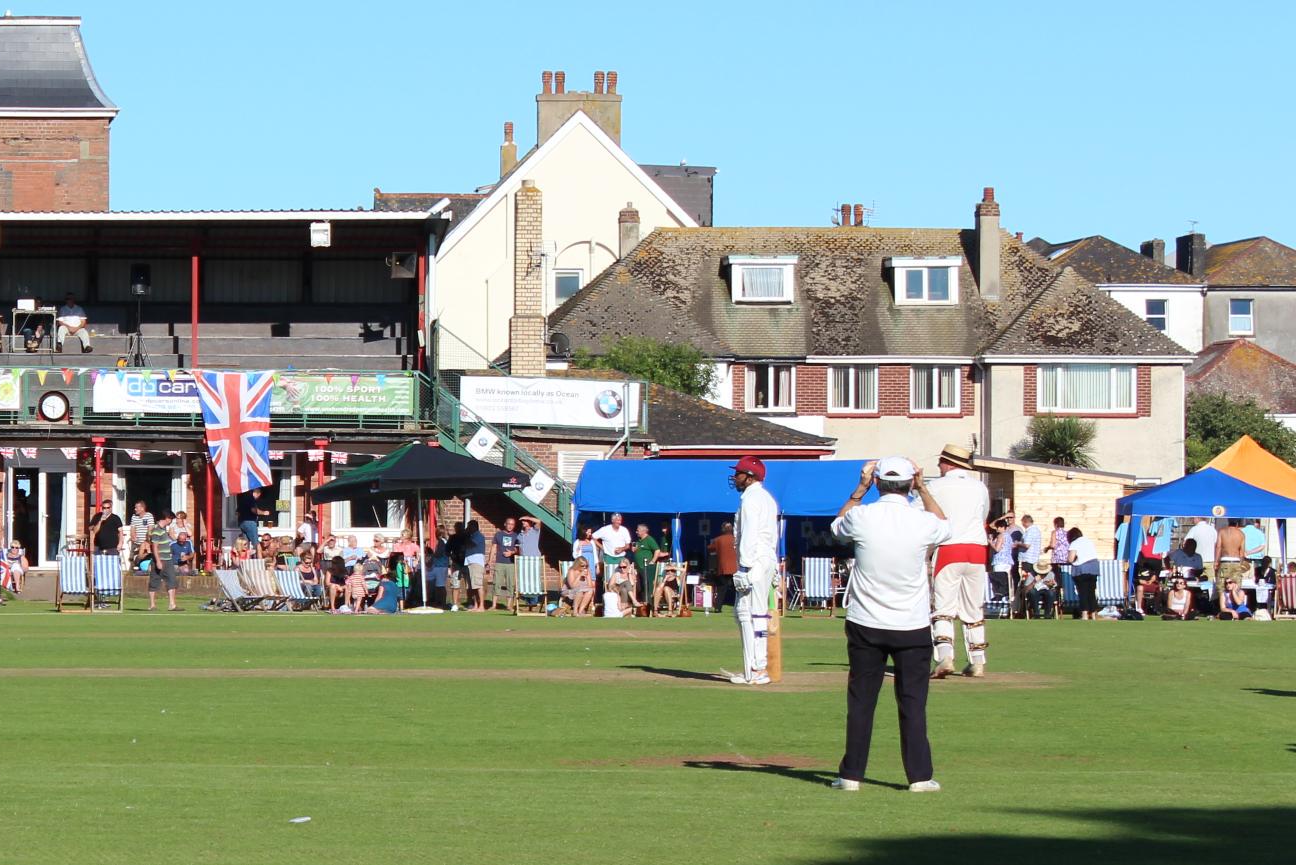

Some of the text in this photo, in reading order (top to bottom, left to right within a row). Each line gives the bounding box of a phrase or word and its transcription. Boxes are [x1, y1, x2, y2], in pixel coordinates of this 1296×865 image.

[159, 382, 196, 393] car
[347, 385, 382, 393] SPORT
[475, 387, 495, 395] BMW
[521, 389, 544, 398] locally
[556, 390, 579, 398] Ocean
